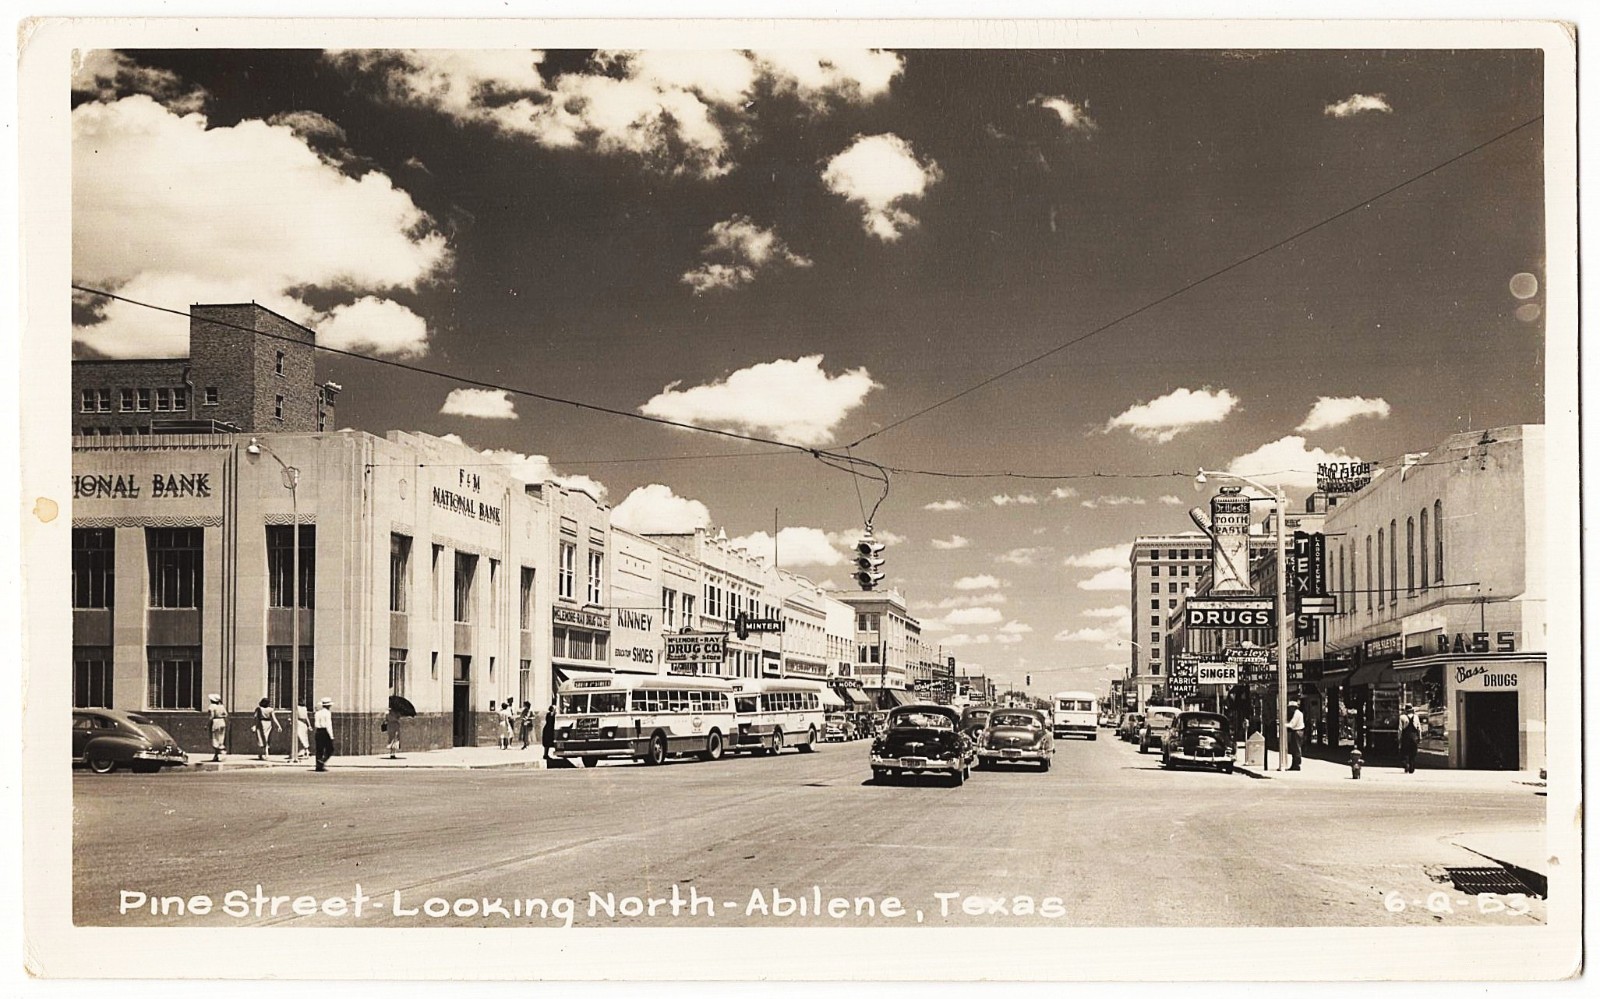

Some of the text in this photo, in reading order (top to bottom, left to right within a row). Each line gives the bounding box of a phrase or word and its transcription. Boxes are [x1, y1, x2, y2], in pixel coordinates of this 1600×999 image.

[71, 473, 212, 496] IONAL BANK
[432, 486, 501, 523] NATIONAL BANK
[1215, 516, 1249, 524] TOOTH
[1215, 526, 1249, 534] PASTE
[1297, 538, 1309, 629] TEXS
[617, 608, 653, 632] KINNEY
[1190, 610, 1269, 625] DRUGS
[746, 622, 780, 630] MINTER
[668, 643, 721, 653] DRUG CO.
[1437, 631, 1516, 653] BASS
[632, 647, 654, 663] SHOES
[1199, 668, 1236, 679] SINGER
[1455, 664, 1488, 683] Bass
[1483, 673, 1518, 687] DRUGS
